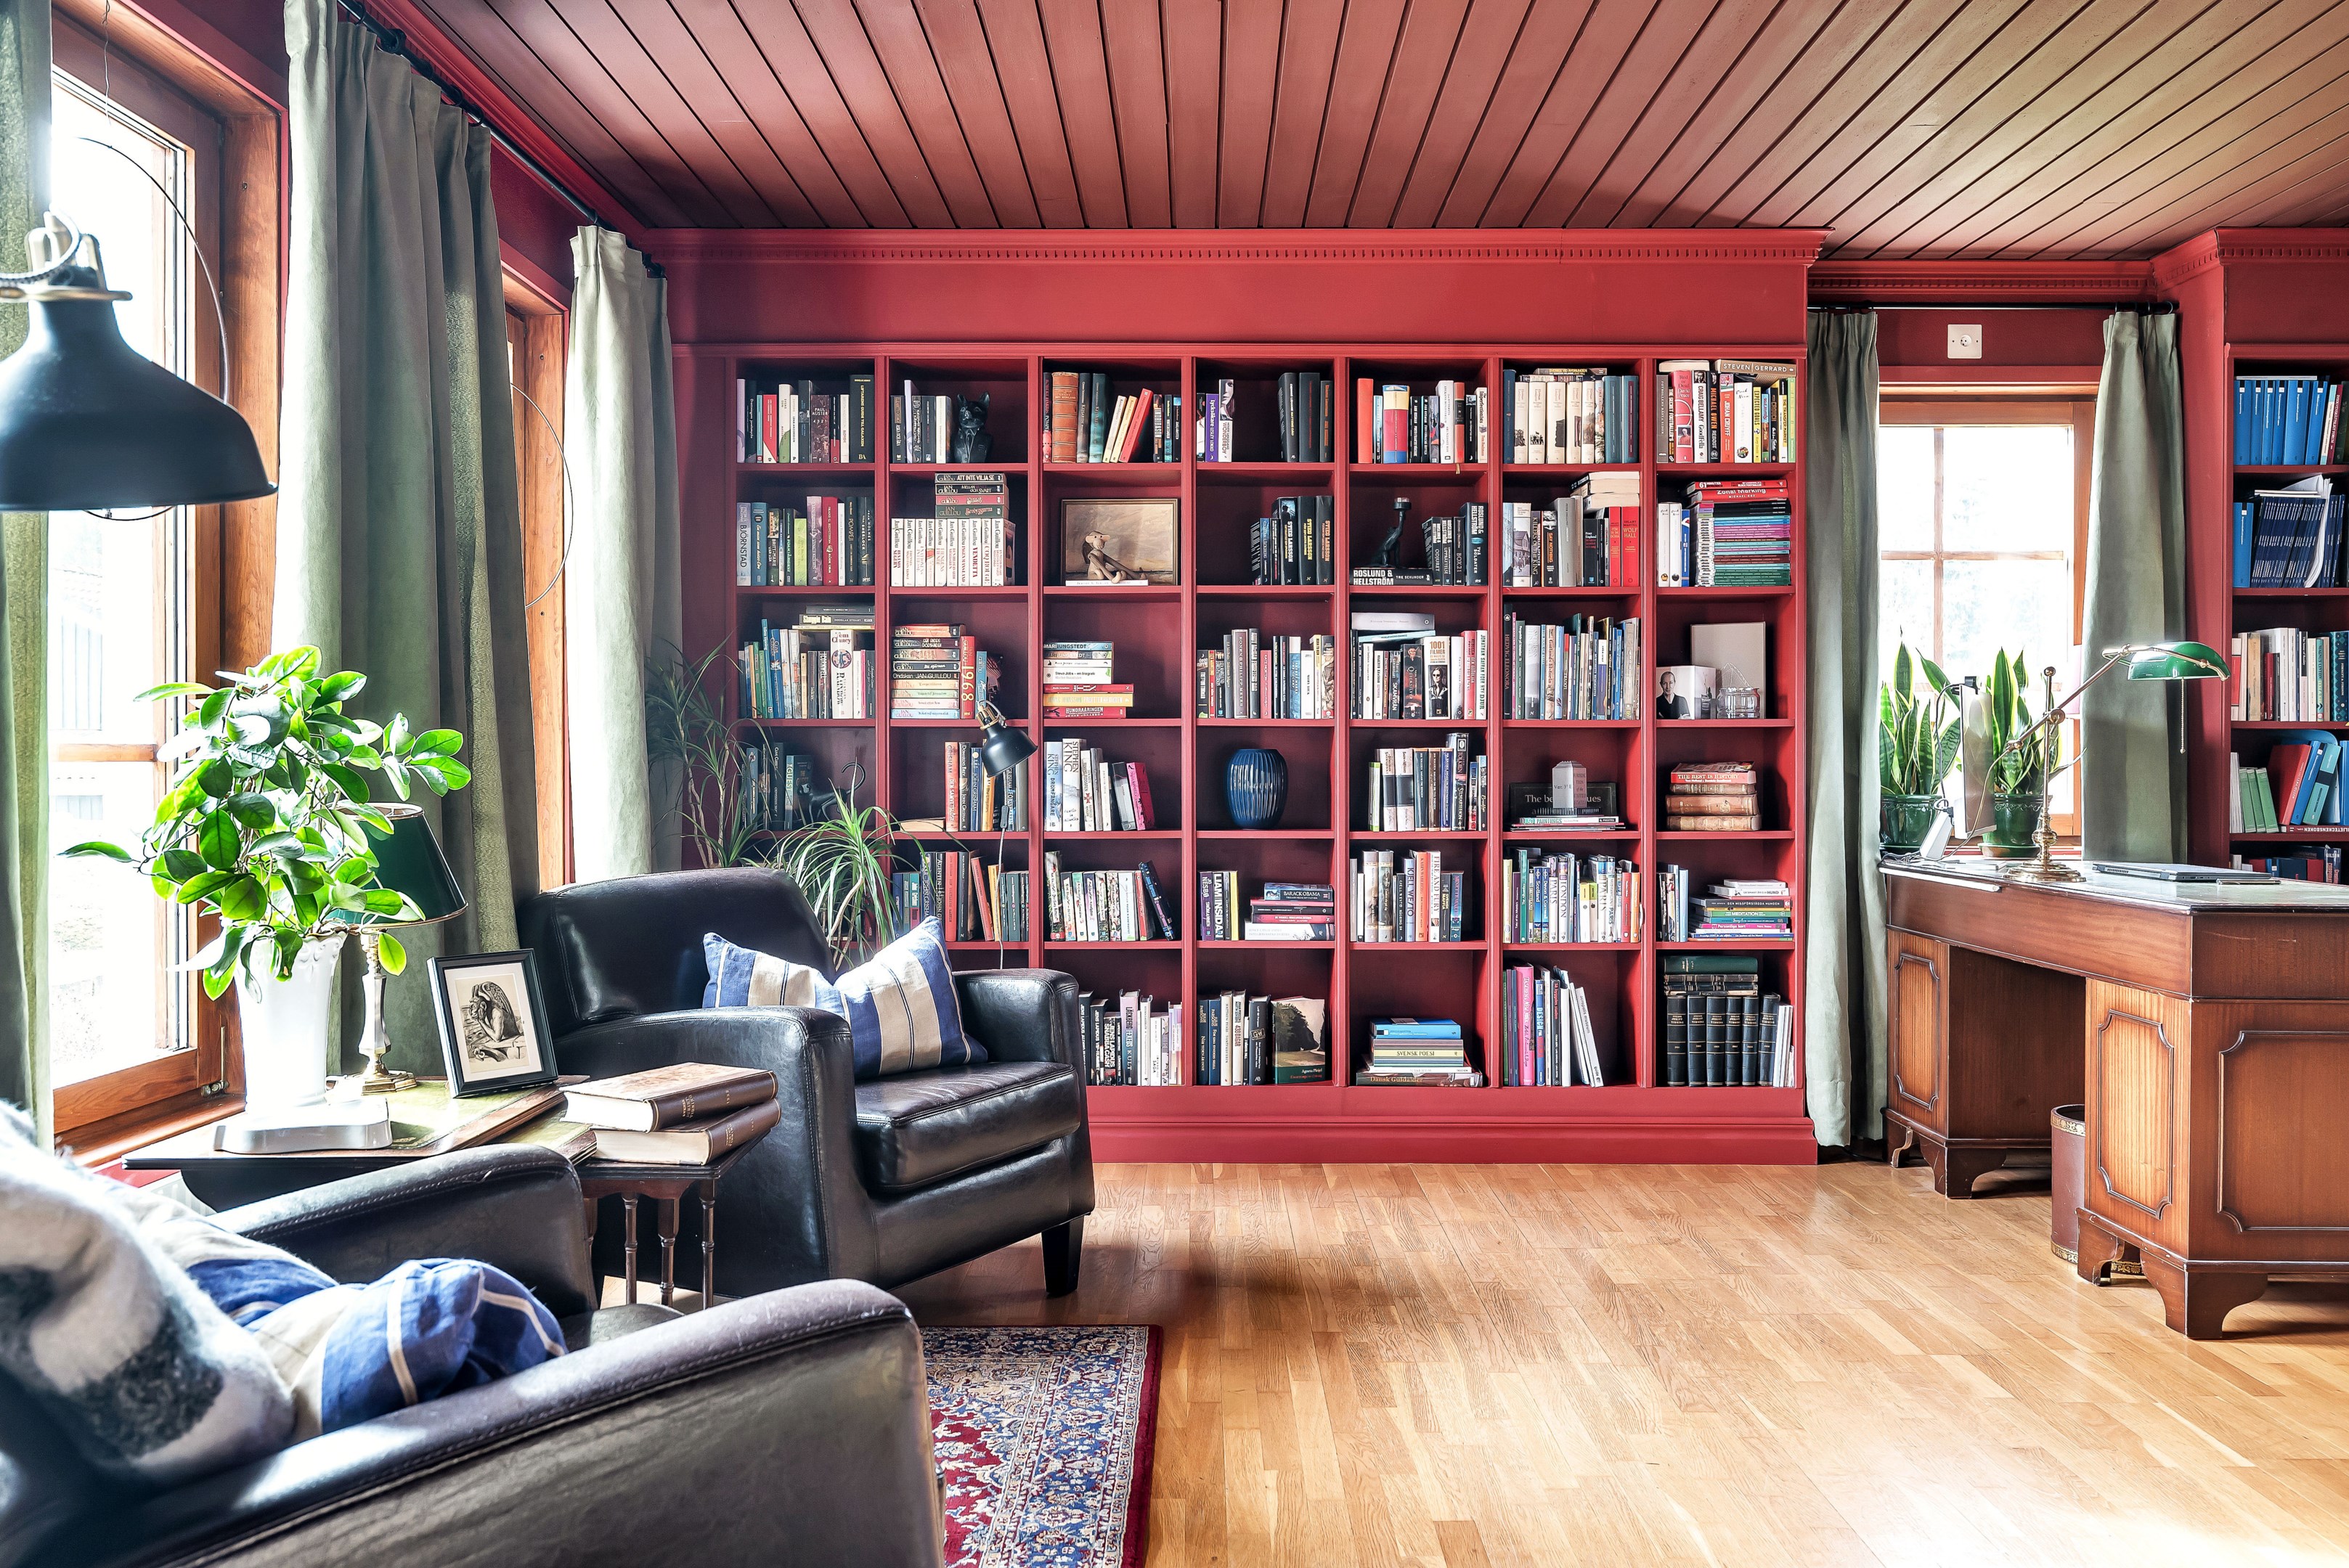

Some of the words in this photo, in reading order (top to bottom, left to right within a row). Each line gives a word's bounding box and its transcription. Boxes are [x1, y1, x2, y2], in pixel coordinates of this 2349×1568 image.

[1457, 563, 1462, 572] 21
[961, 666, 974, 701] 1968
[1063, 742, 1072, 772] KING
